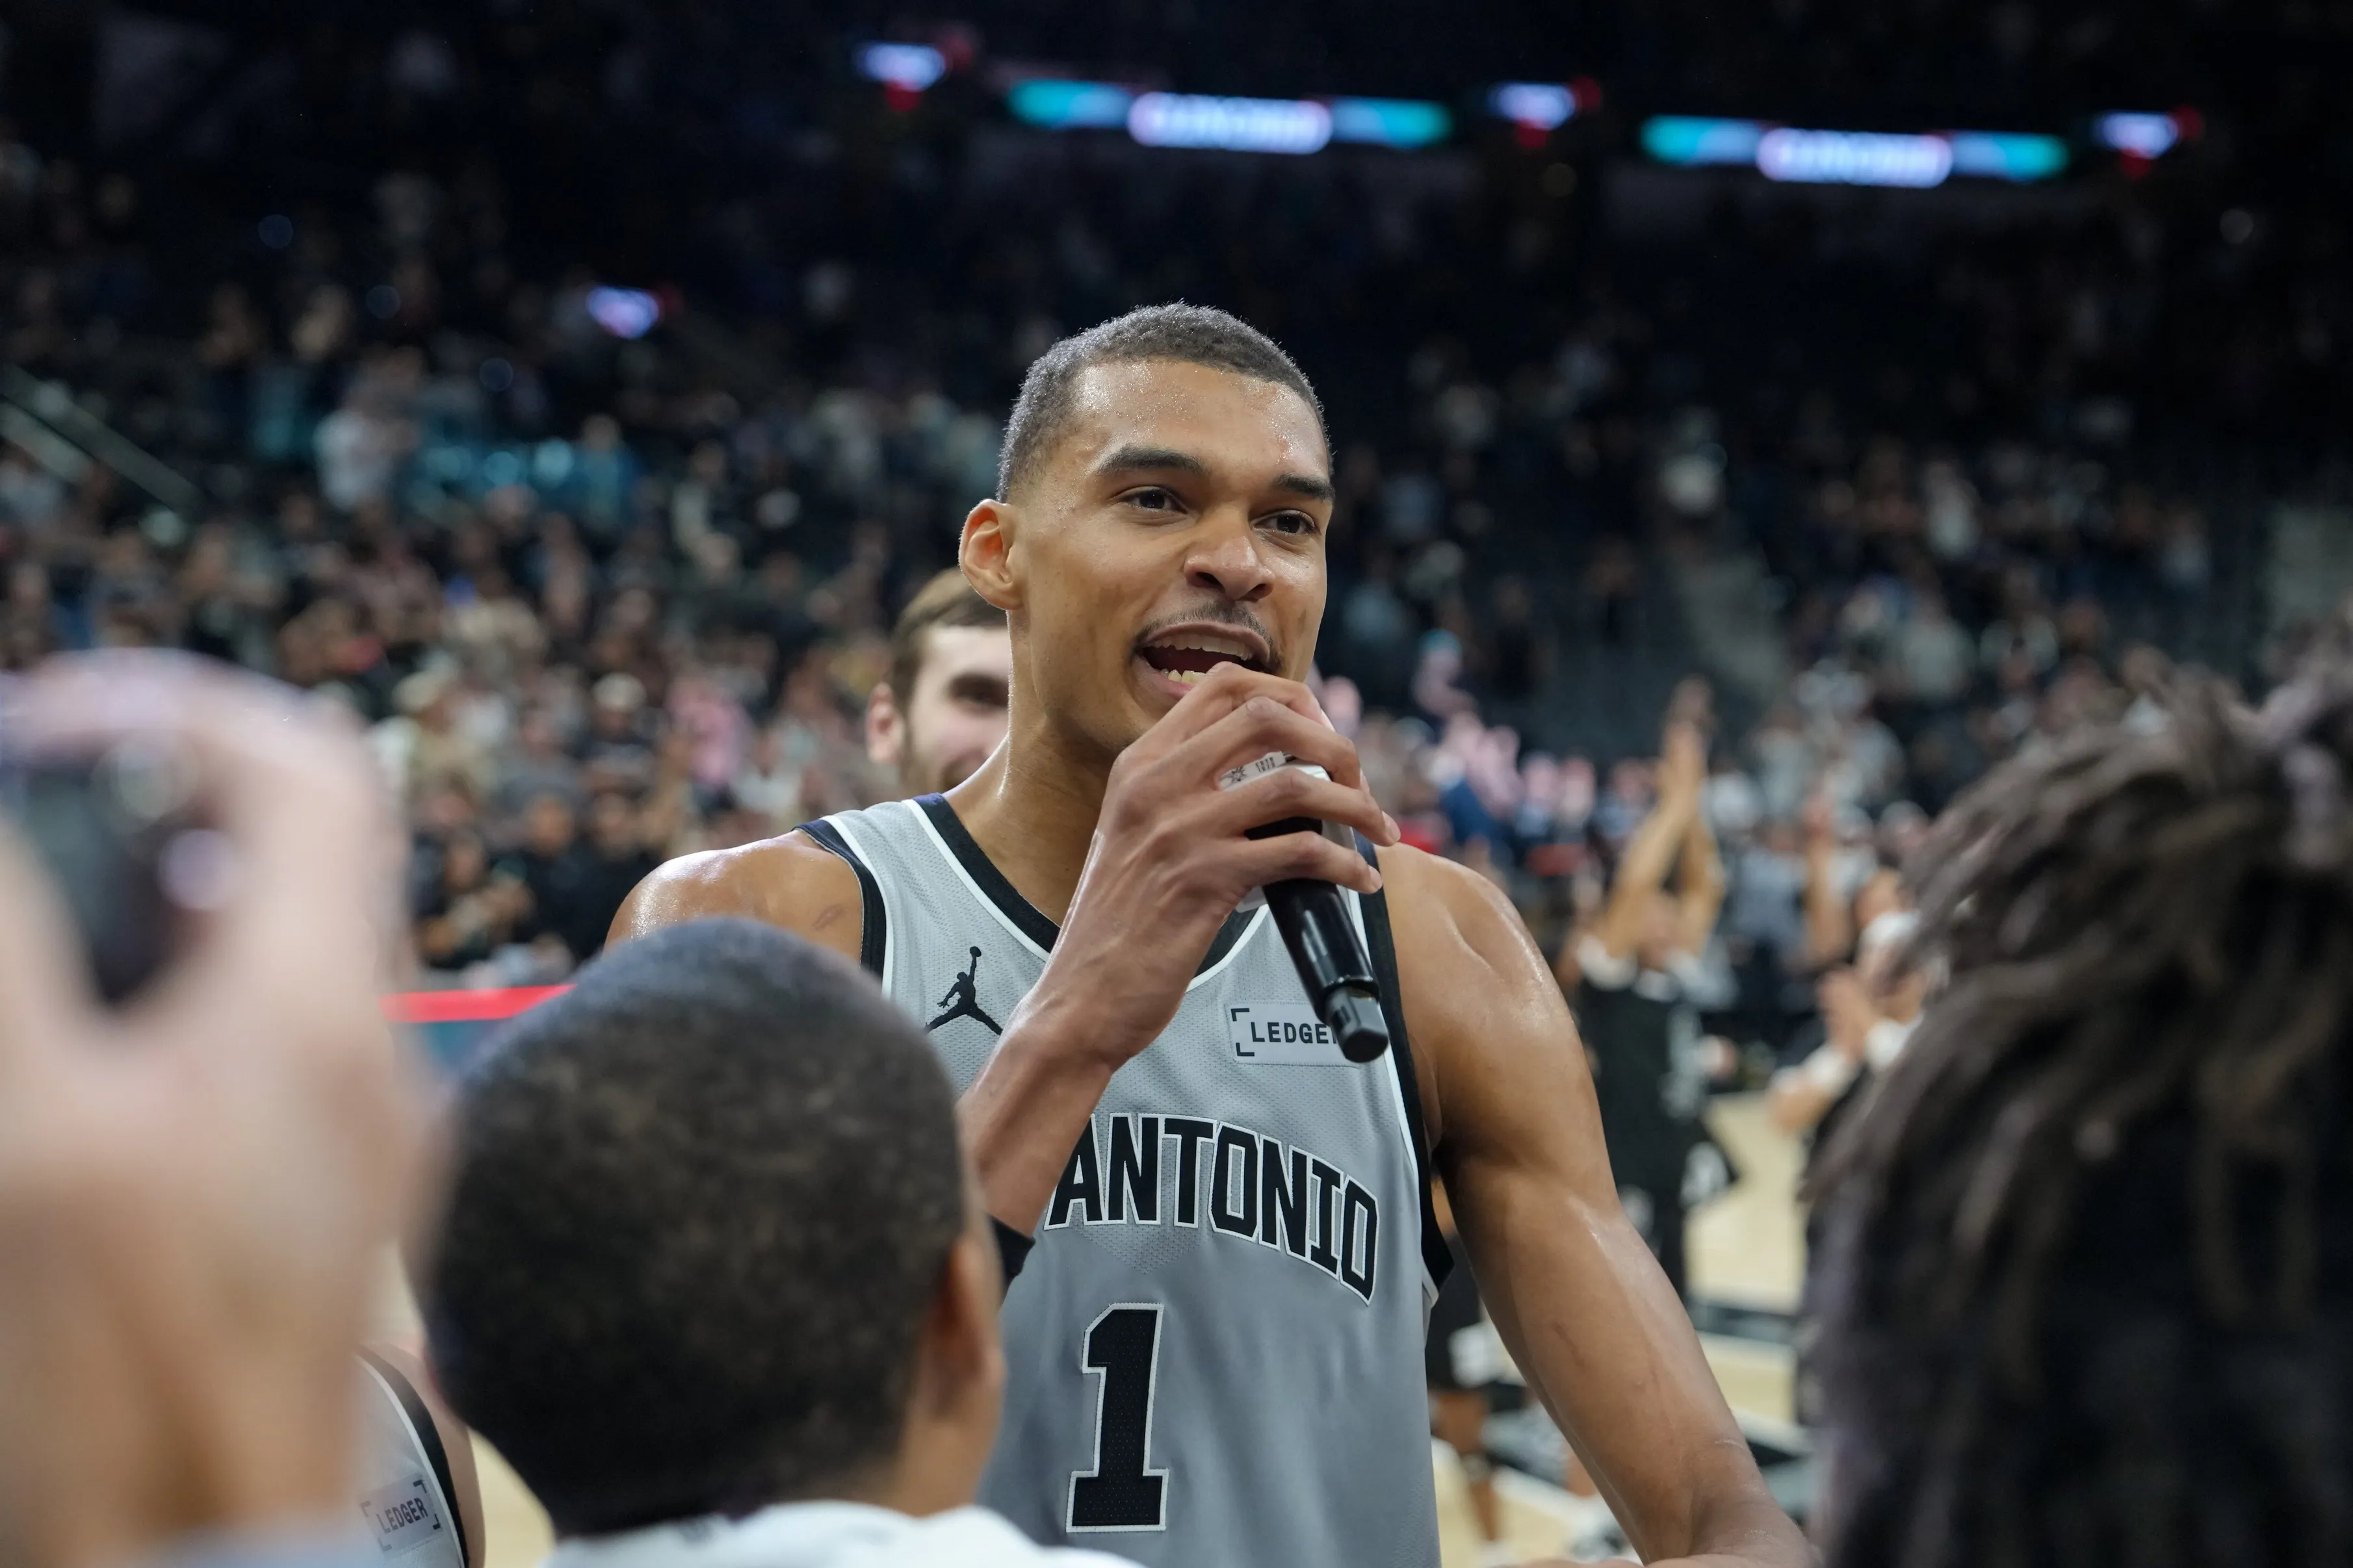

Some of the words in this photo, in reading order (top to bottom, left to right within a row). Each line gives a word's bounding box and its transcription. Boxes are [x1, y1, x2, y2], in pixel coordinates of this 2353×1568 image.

[1251, 1022, 1337, 1044] LEDGE
[1044, 1112, 1379, 1306] ANTONIO
[1066, 1303, 1169, 1532] 1
[376, 1497, 428, 1534] LEDGER
